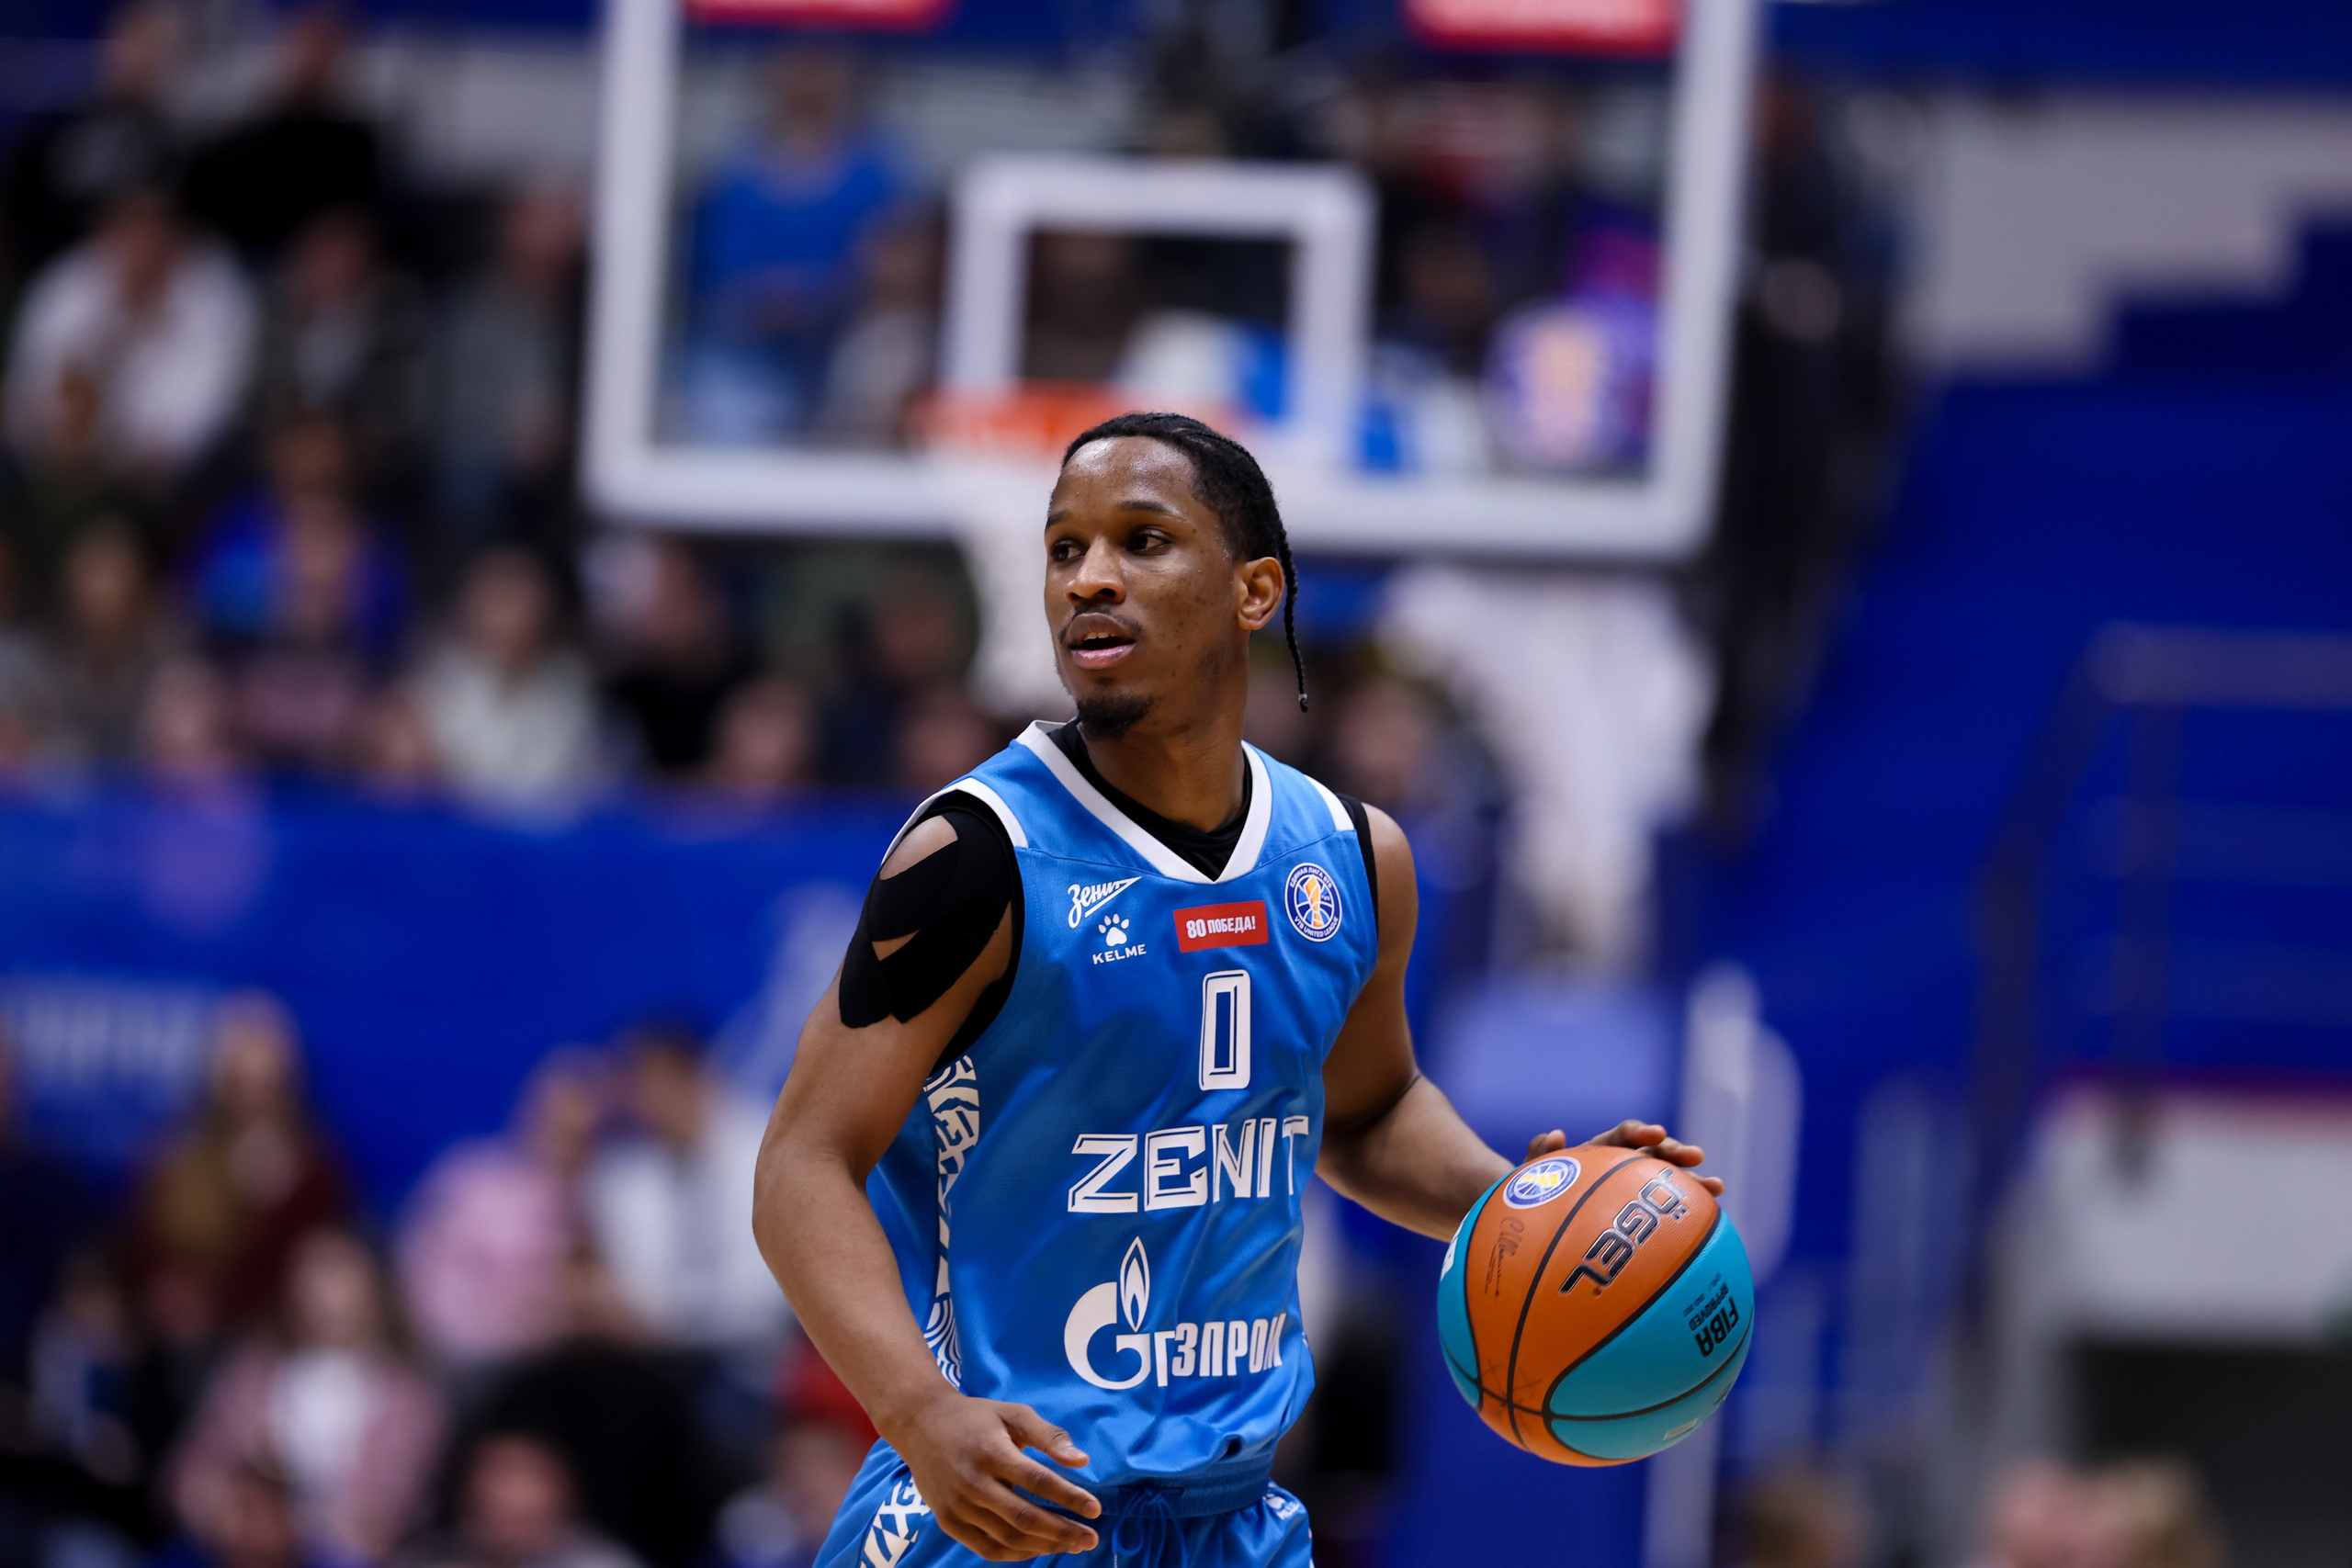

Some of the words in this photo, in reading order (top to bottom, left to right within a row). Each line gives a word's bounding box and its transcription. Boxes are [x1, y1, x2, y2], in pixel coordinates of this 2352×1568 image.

[1092, 943, 1147, 965] KELME
[1186, 919, 1207, 939] 80
[1207, 916, 1256, 934] ПОБЕДА!
[1295, 916, 1305, 930] VTB
[1198, 969, 1250, 1090] 0
[1068, 1115, 1309, 1213] ZENIT
[1558, 1167, 1689, 1294] JÖGEL
[1694, 1296, 1740, 1358] FIBA
